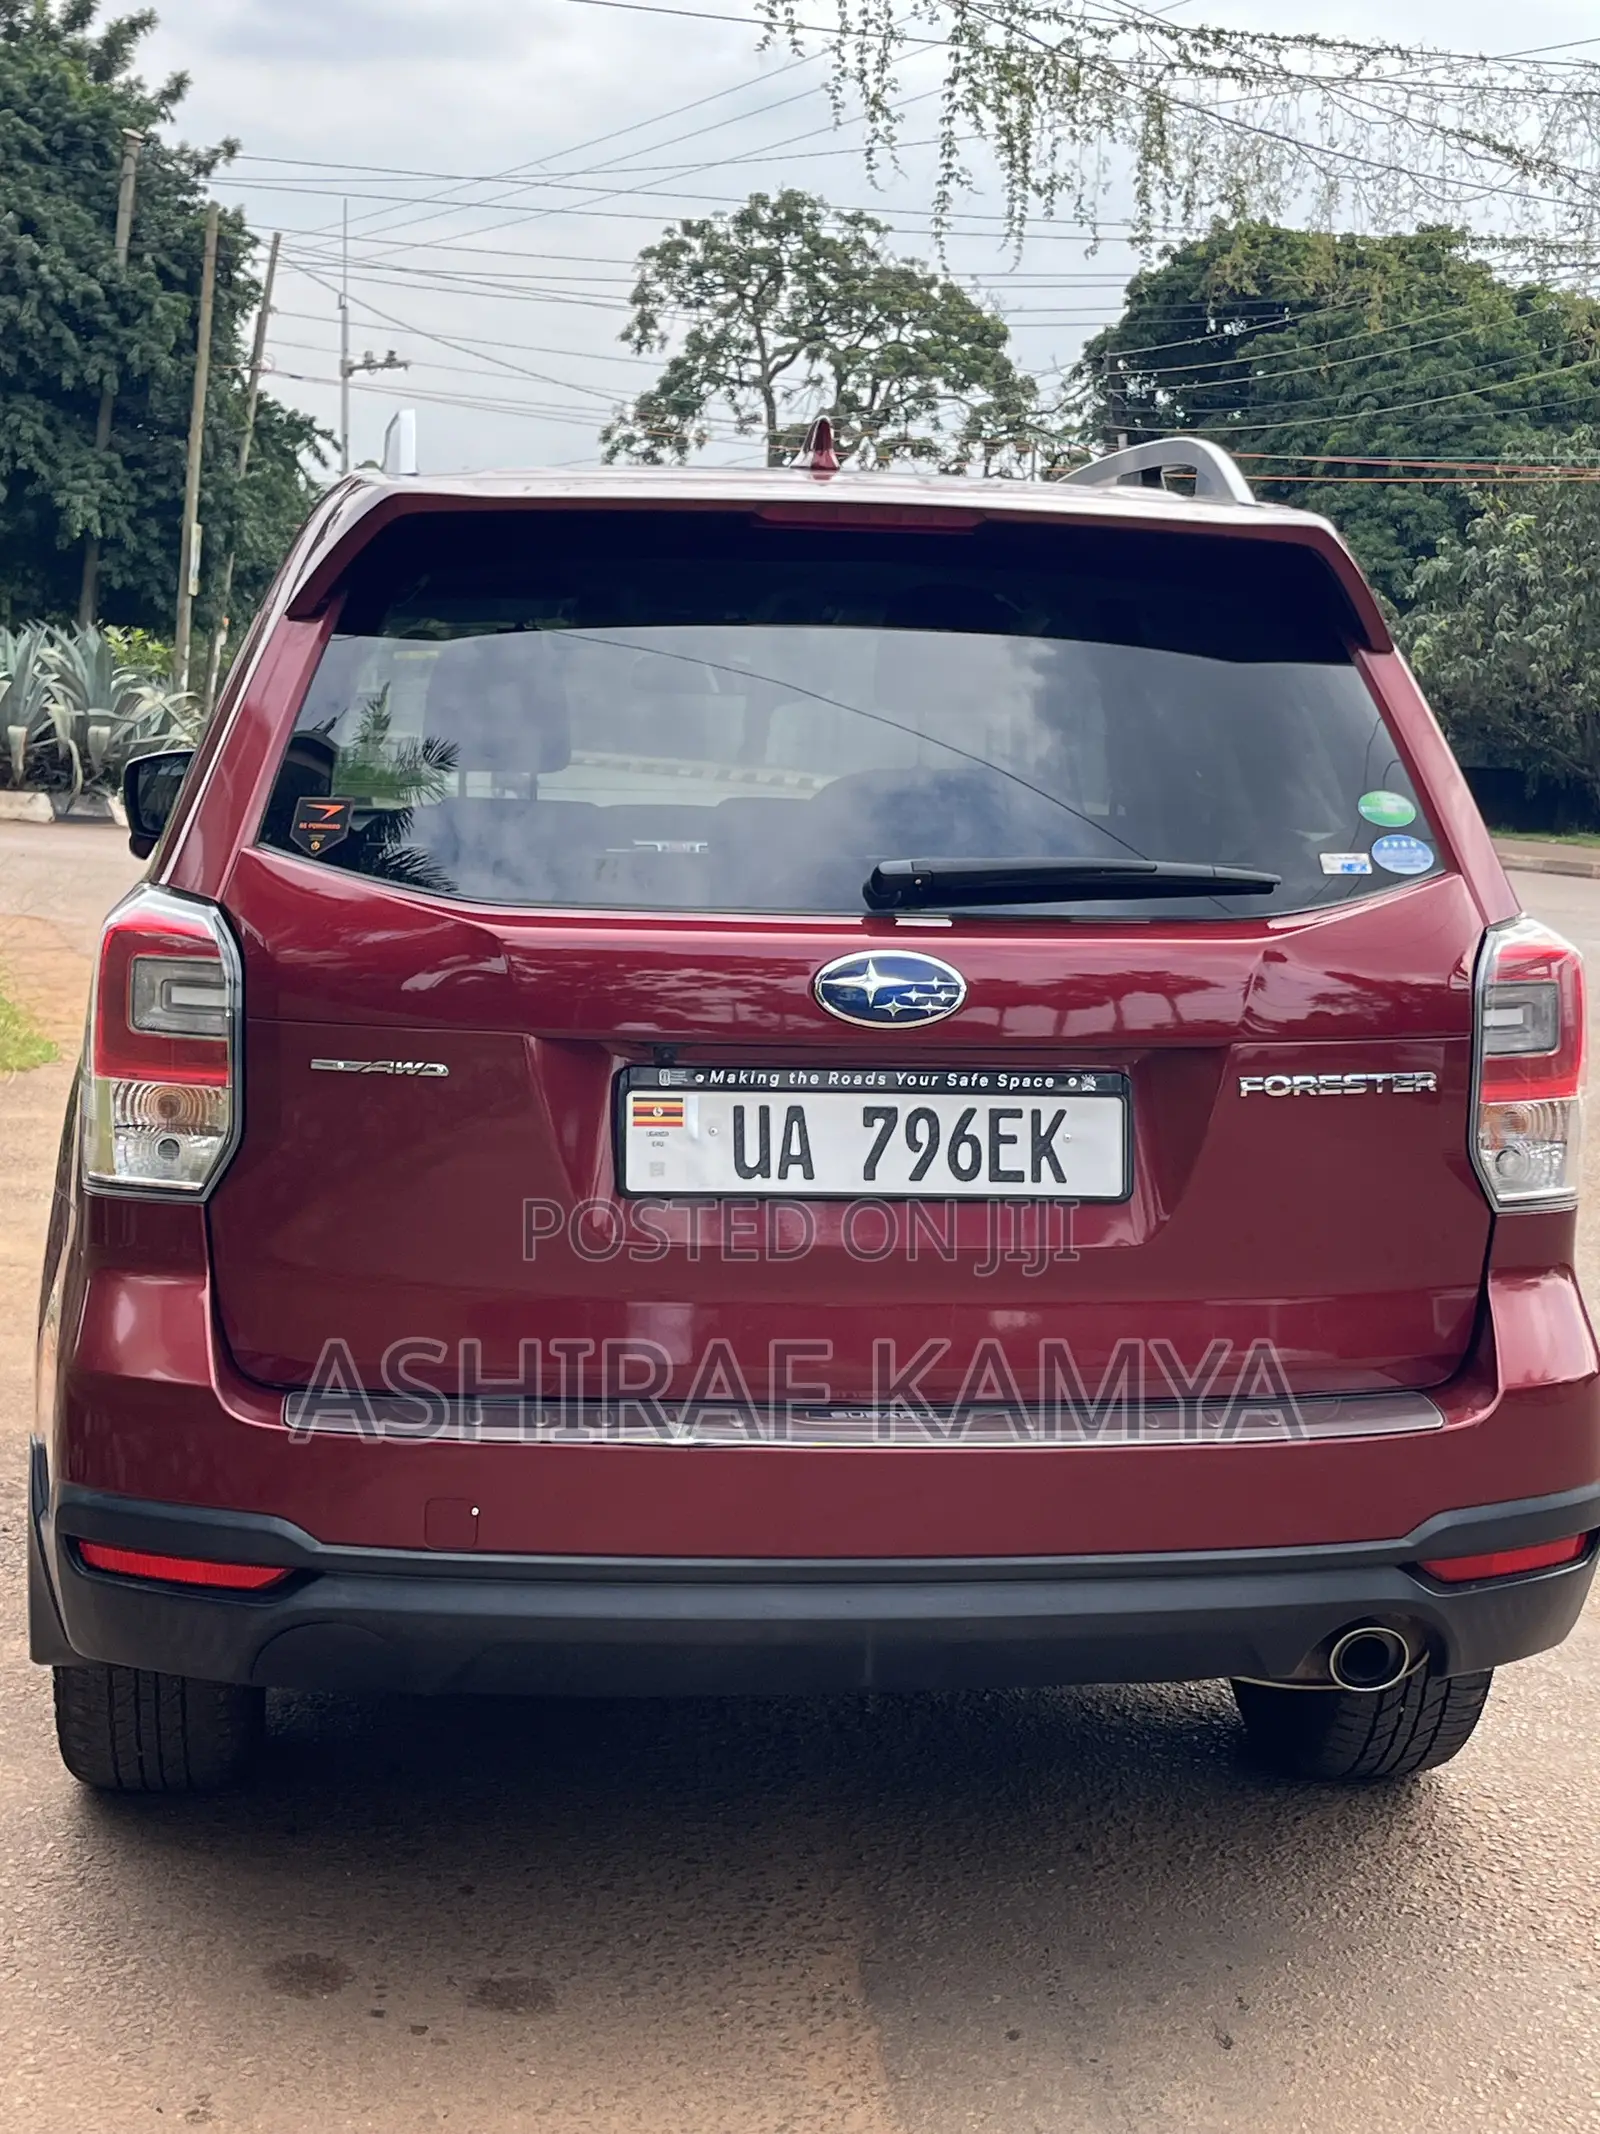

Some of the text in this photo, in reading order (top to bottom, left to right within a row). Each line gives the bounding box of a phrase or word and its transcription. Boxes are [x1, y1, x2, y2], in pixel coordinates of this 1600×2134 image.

[709, 1070, 1055, 1090] Making the Roads Your Safe Space
[1239, 1071, 1437, 1098] FORESTER
[732, 1104, 1068, 1184] UA 796EK
